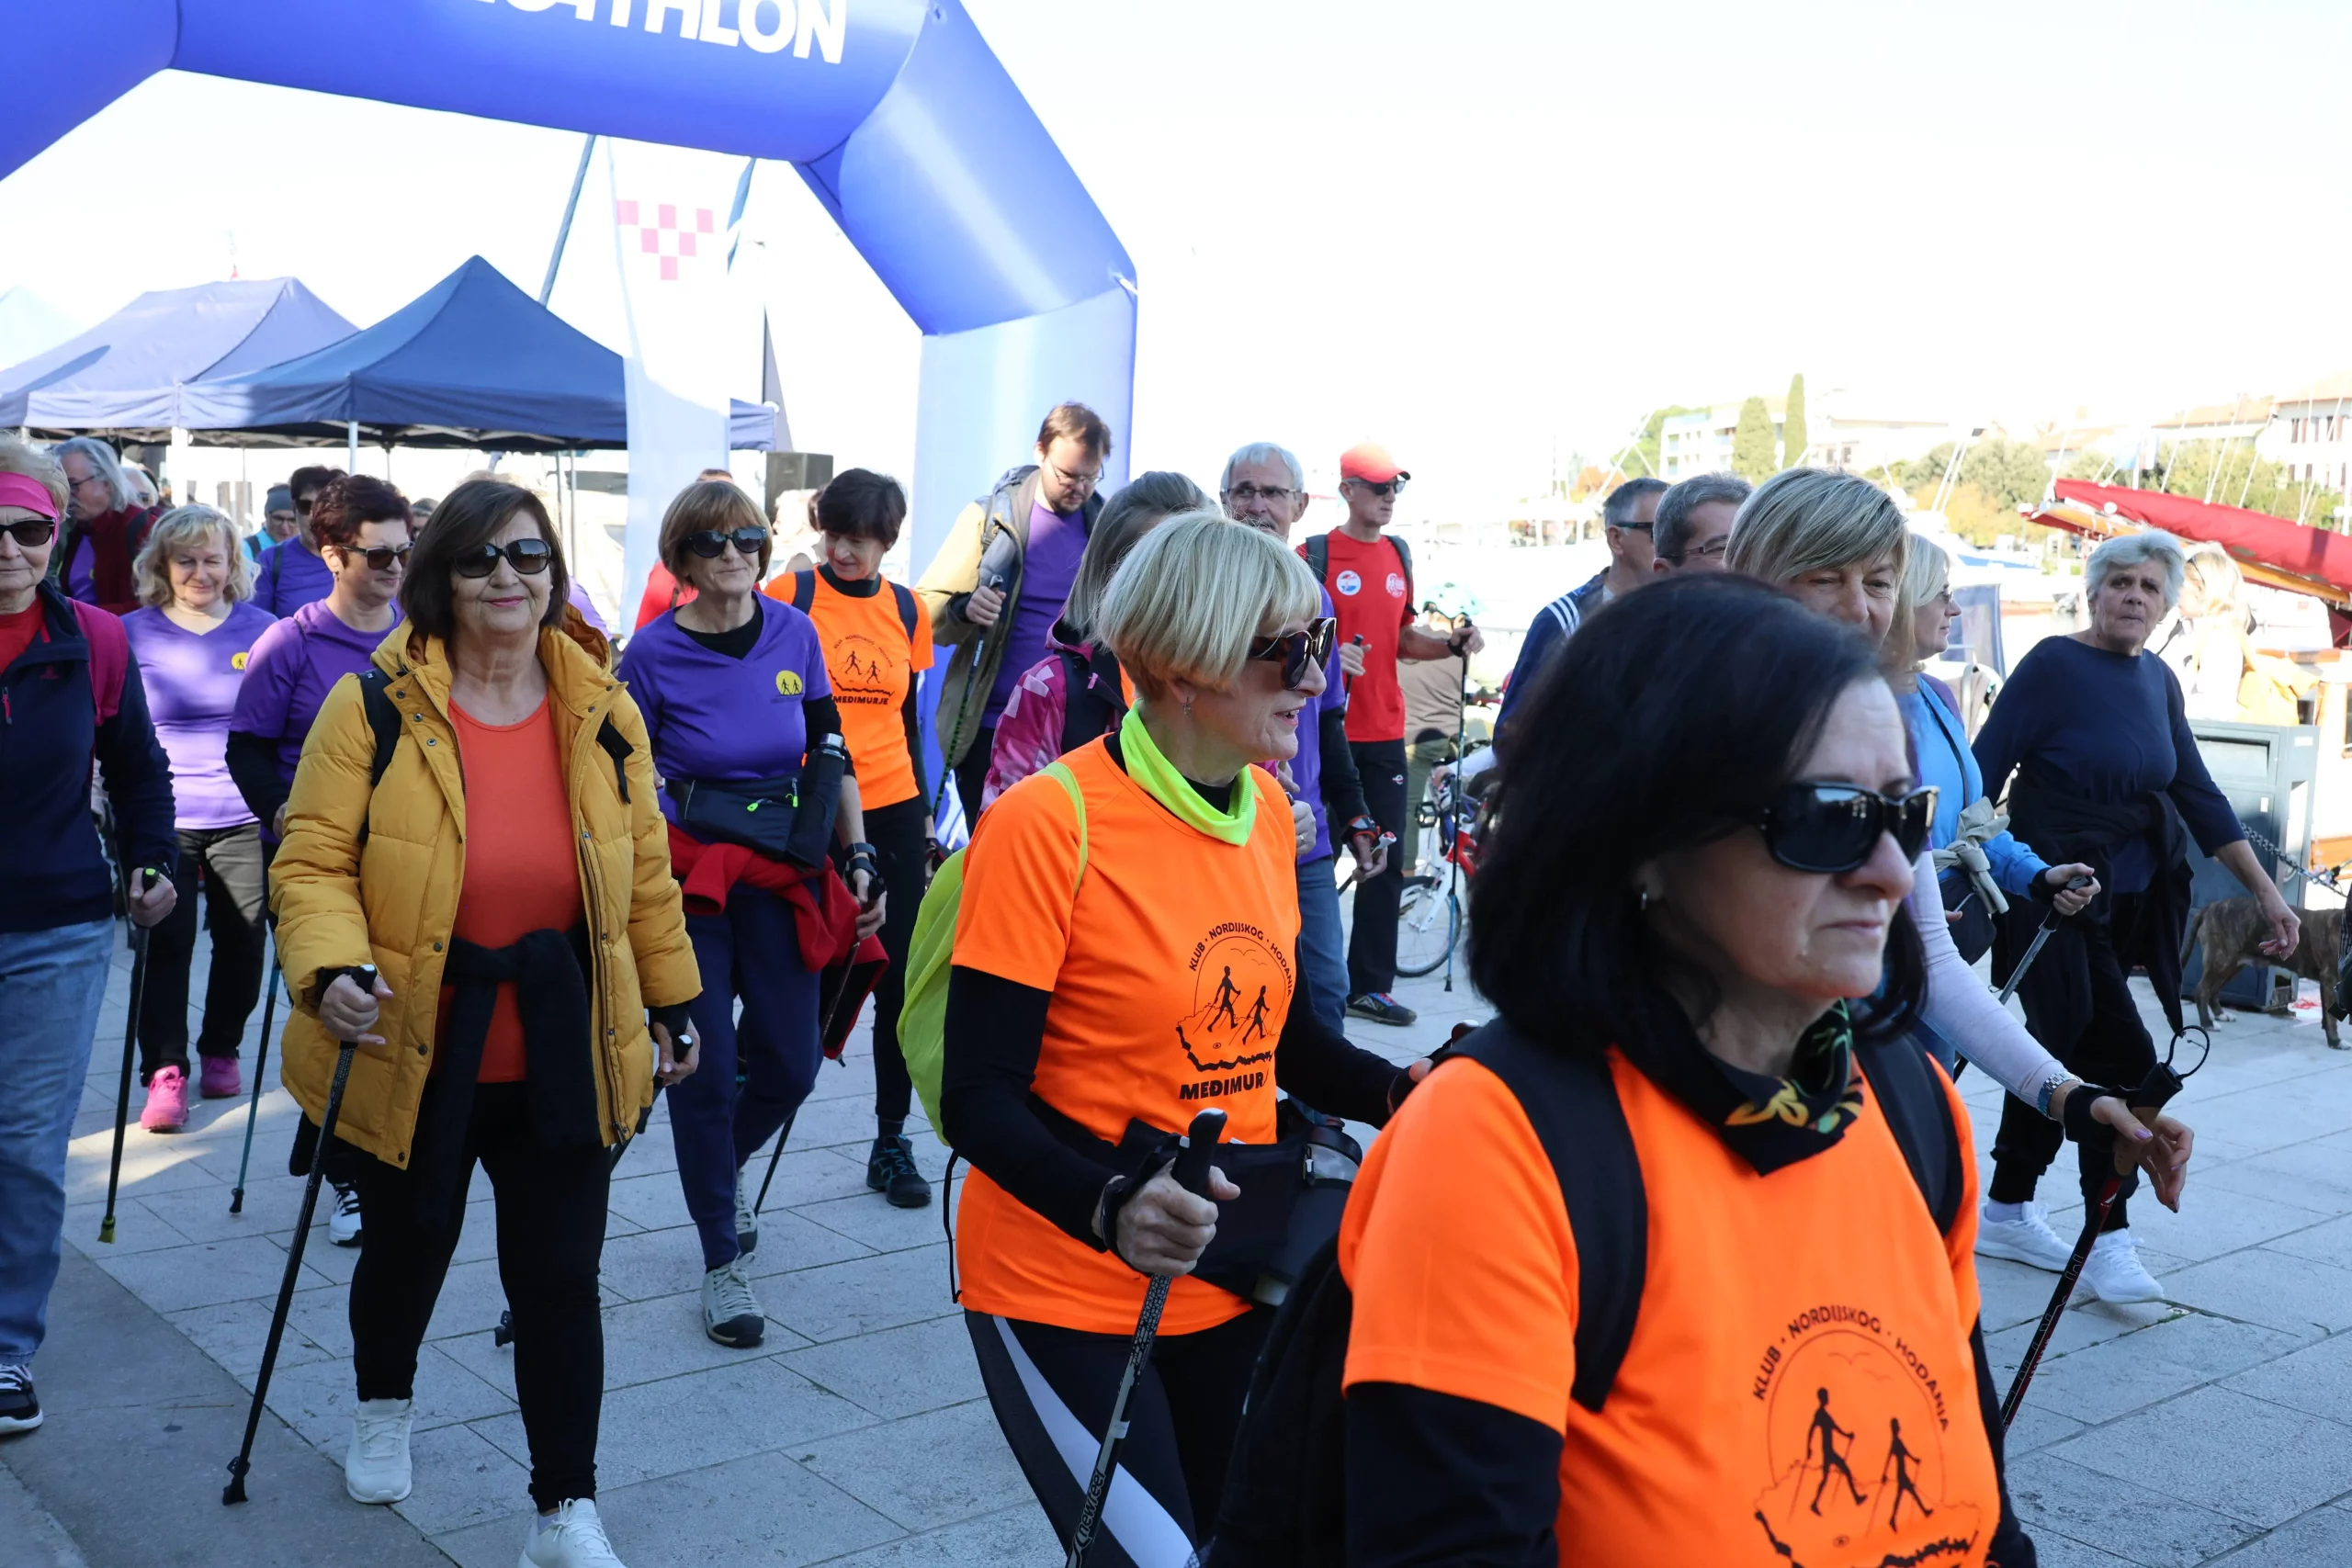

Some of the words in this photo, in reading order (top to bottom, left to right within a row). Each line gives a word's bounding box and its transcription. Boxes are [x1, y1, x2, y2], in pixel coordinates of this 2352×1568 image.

[1189, 942, 1205, 971] KLUB
[1209, 922, 1264, 941] NORDIJSKOG
[1179, 1069, 1269, 1100] MEĐIMUR
[1753, 1346, 1781, 1401] KLUB
[1787, 1304, 1882, 1340] NORDIJSKOG
